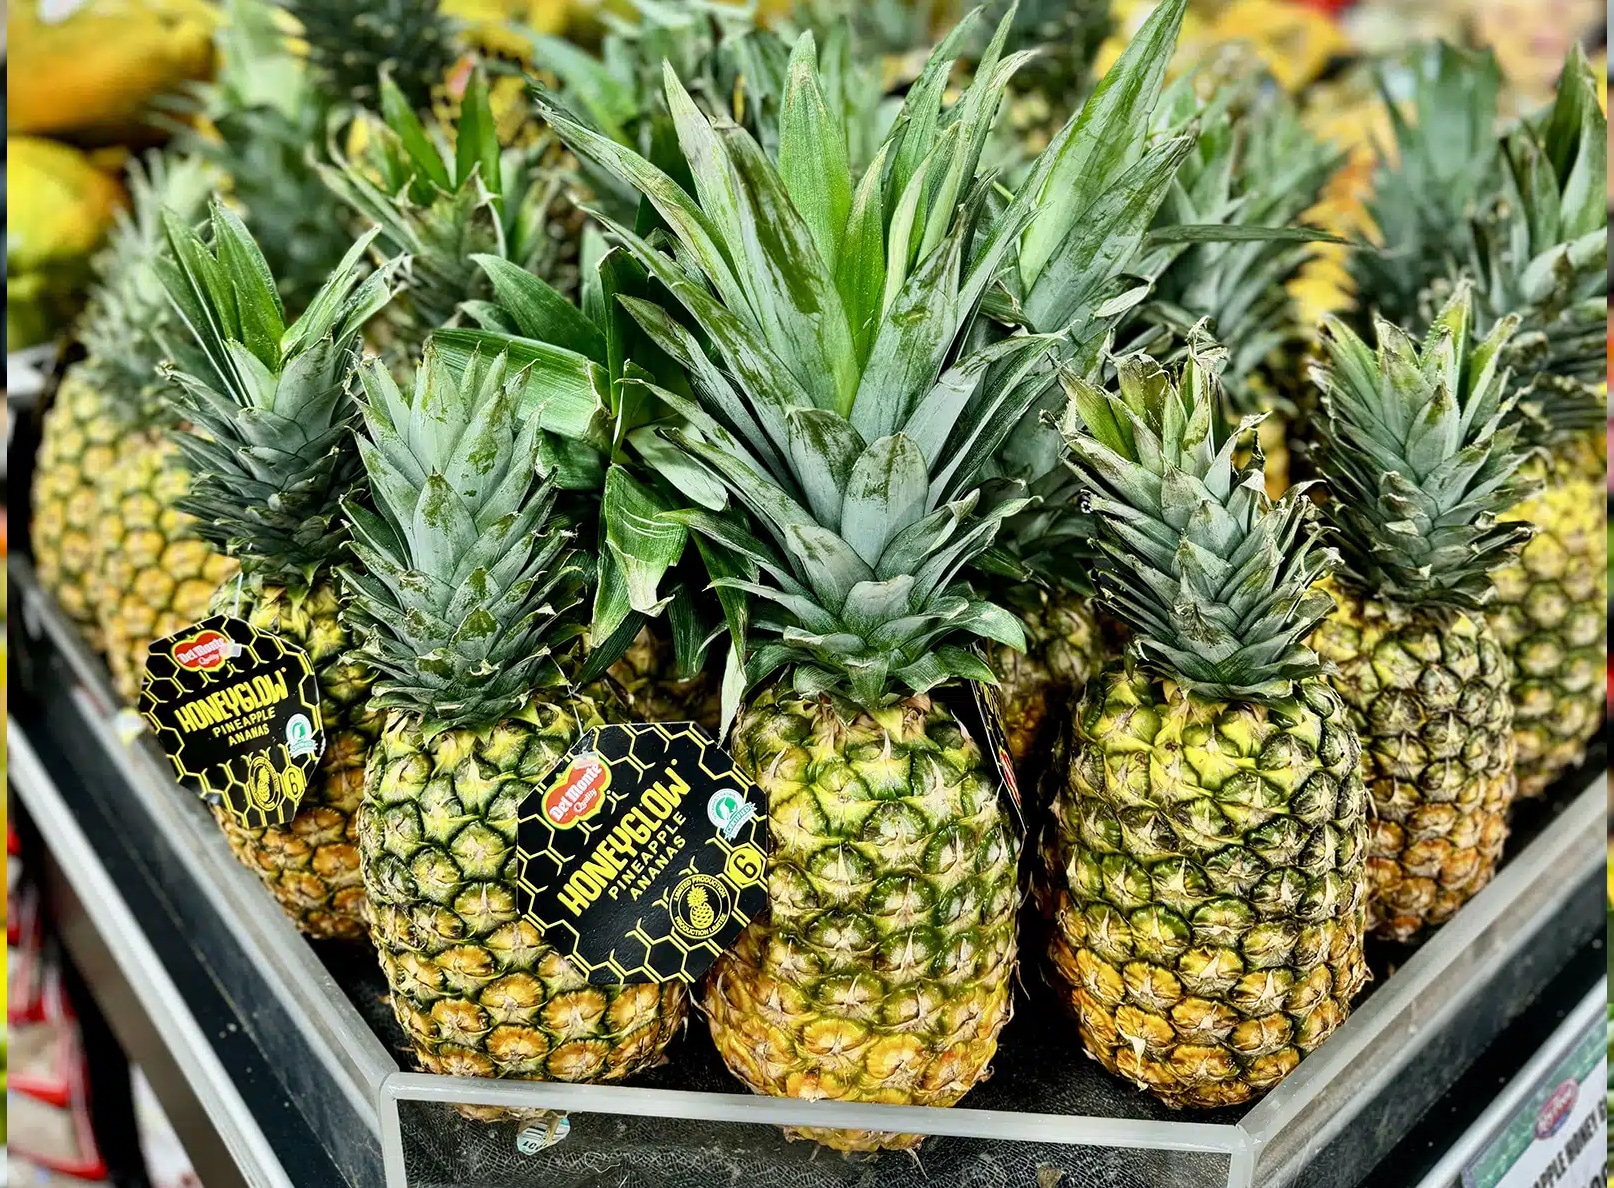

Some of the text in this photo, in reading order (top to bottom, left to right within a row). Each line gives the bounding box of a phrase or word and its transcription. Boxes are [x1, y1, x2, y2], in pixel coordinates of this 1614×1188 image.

[174, 669, 288, 733] HONEYGLOW
[212, 706, 276, 738] PINEAPPLE
[228, 723, 270, 747] ANANAS
[289, 771, 299, 795] 6
[549, 763, 603, 822] Del Monte
[573, 788, 598, 813] Quality
[556, 766, 692, 917] HONEYGLOW
[608, 811, 687, 901] PINEAPPLE
[629, 834, 687, 902] ANANAS
[733, 855, 758, 885] 6
[673, 876, 727, 901] LIMITED PRODUCTION
[675, 915, 709, 937] PRODUCTION
